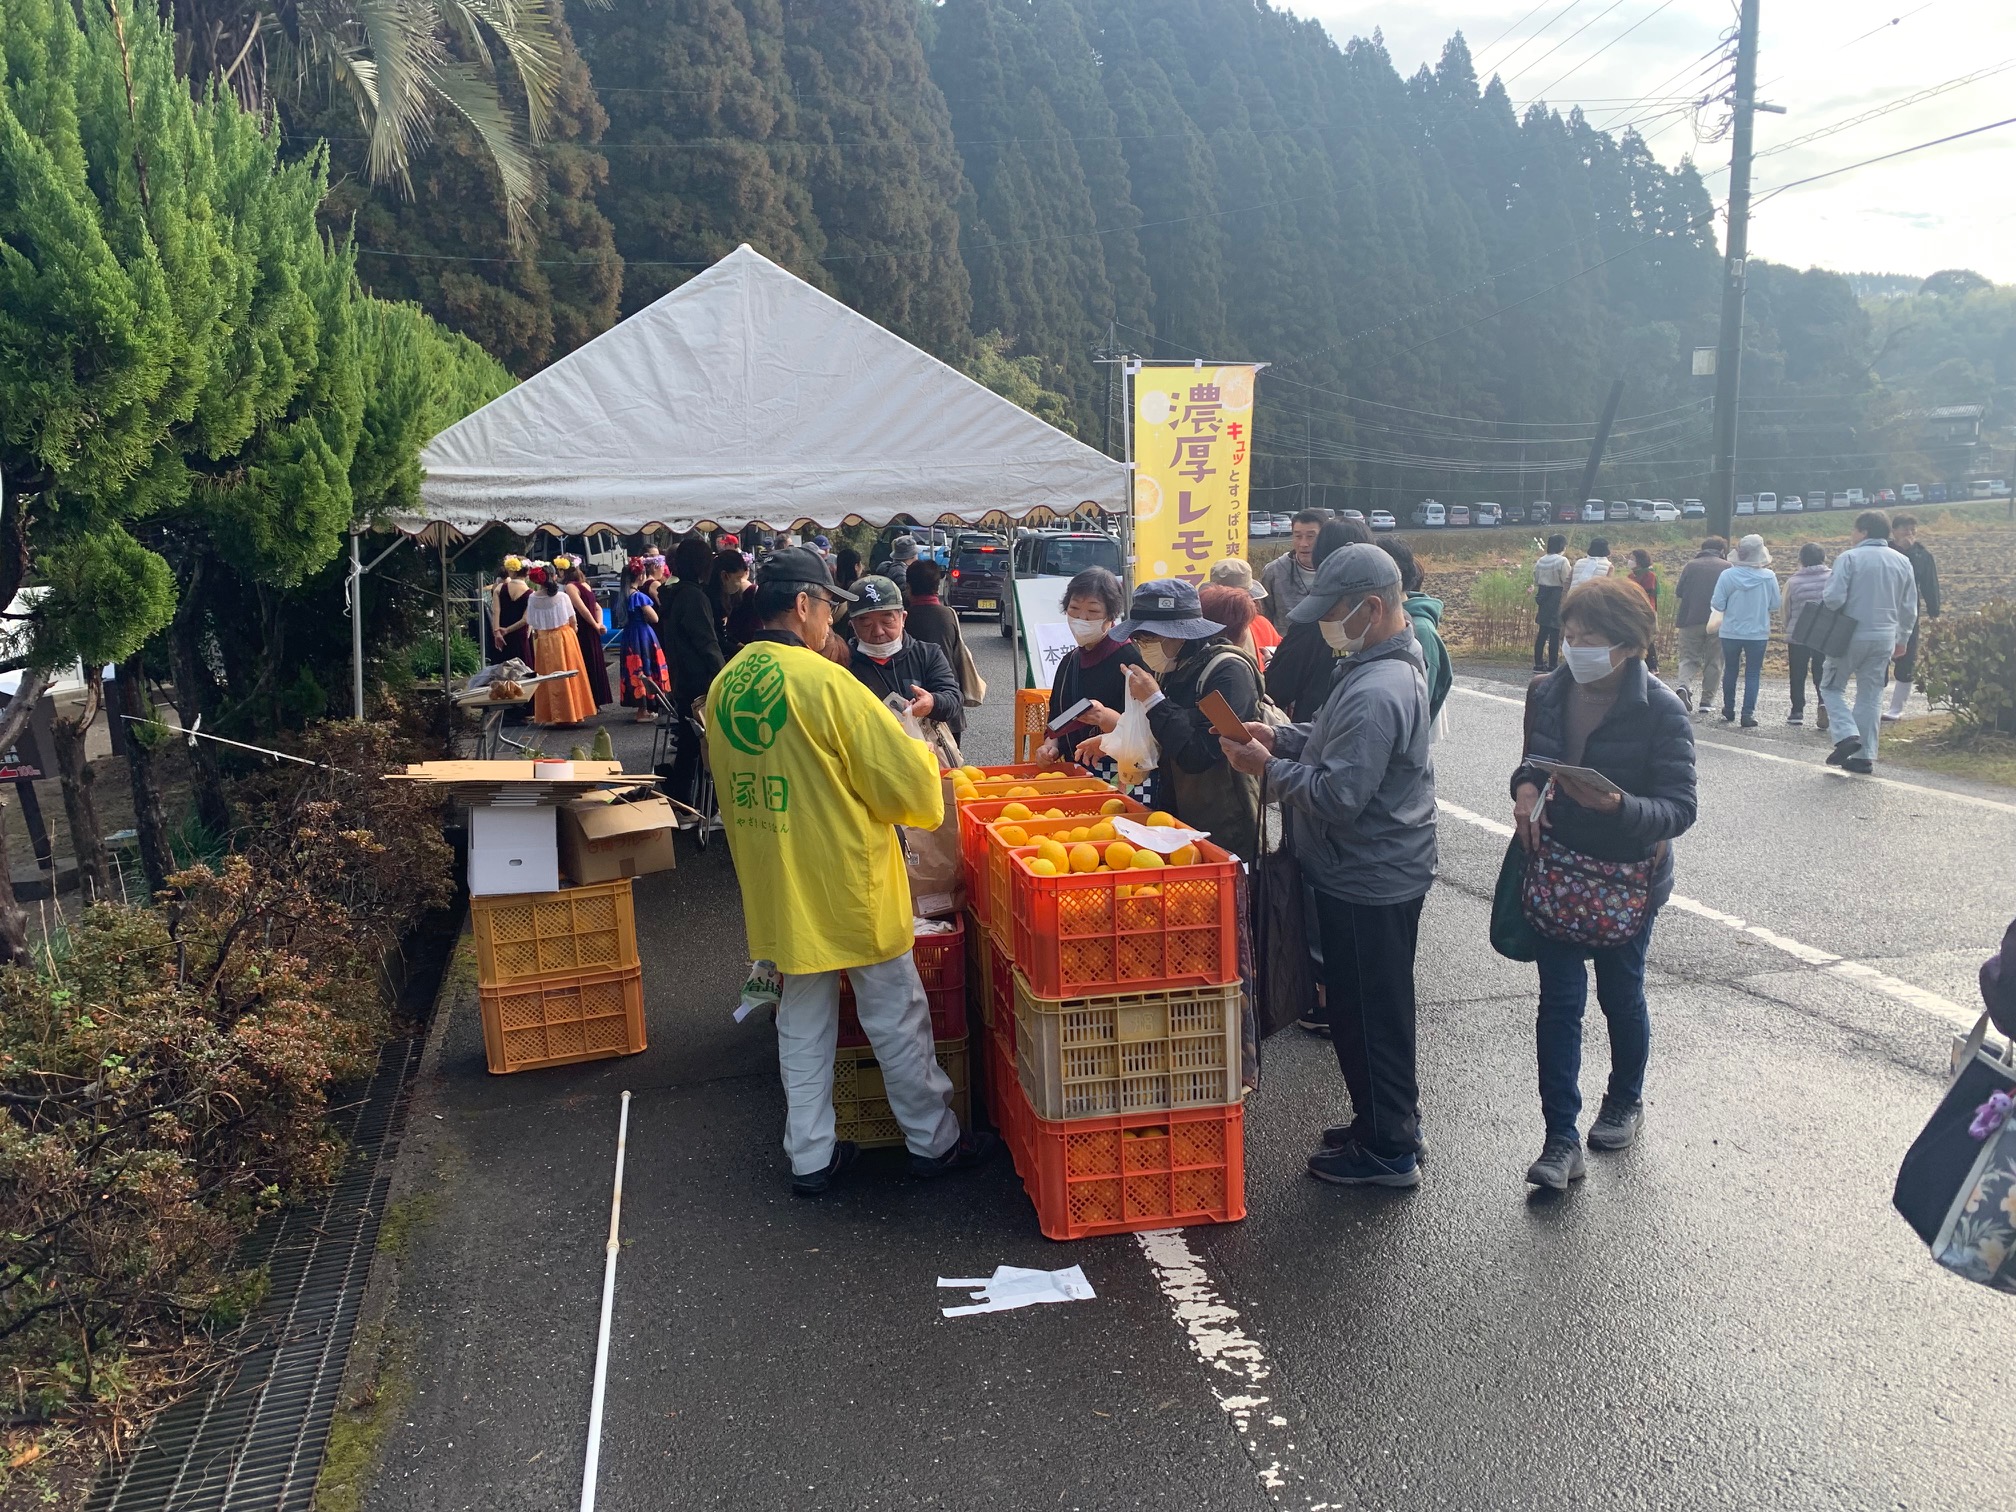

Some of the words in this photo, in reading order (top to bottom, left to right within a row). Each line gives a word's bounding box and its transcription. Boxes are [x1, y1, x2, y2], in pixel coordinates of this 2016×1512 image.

[1225, 421, 1246, 556] キュッとすっぱい爽
[865, 584, 881, 603] Sox
